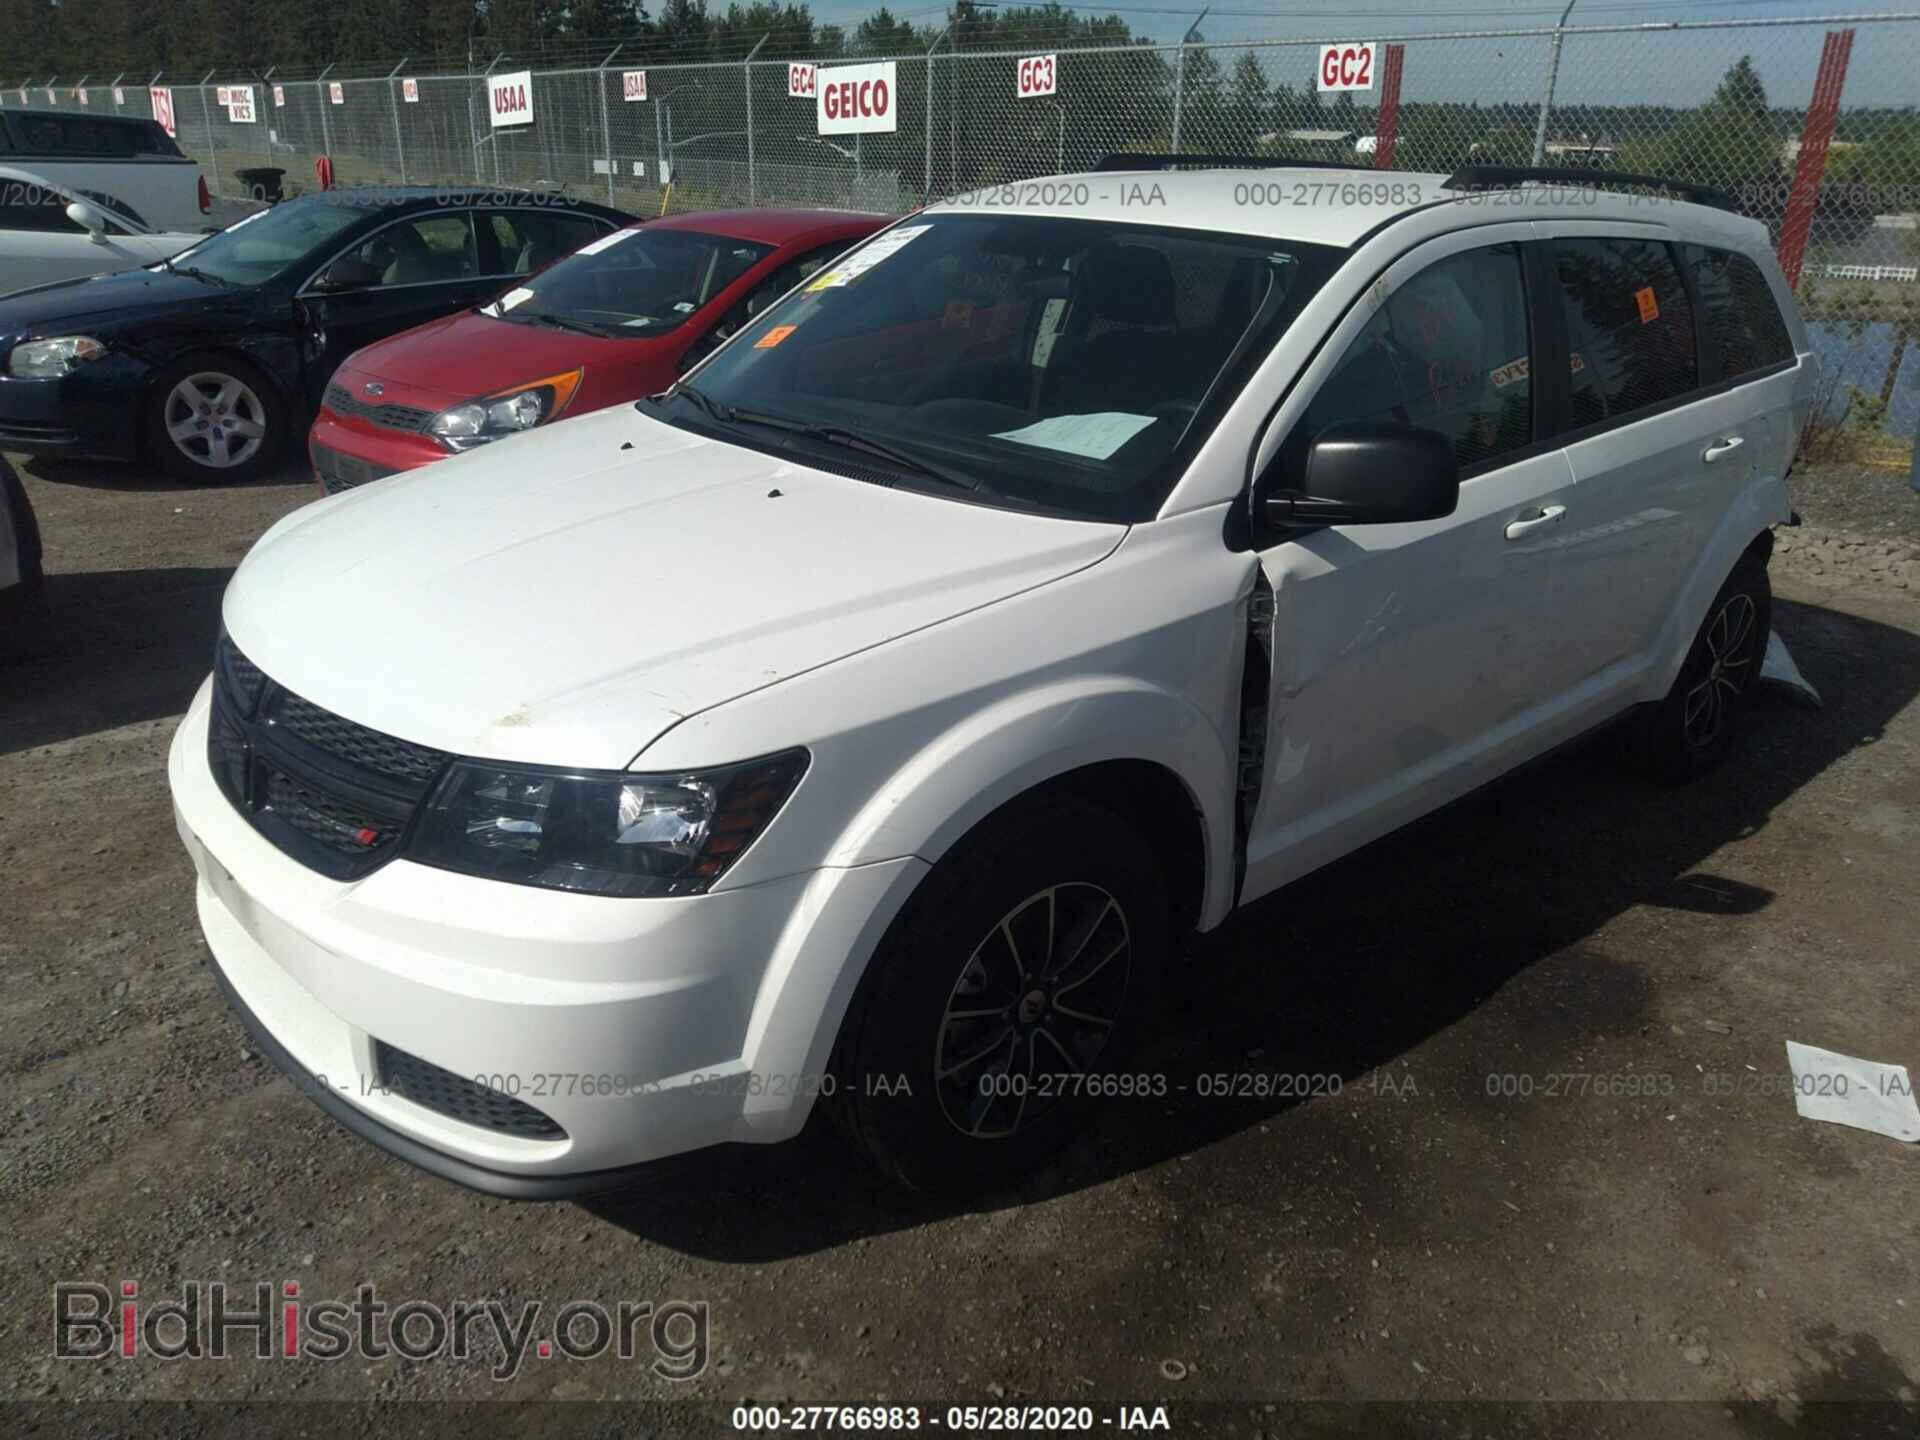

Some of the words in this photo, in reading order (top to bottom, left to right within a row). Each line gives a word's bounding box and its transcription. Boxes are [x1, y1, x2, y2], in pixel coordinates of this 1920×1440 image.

[790, 65, 815, 94] GC4
[1020, 58, 1053, 93] GC3
[1322, 47, 1371, 86] GC2
[494, 84, 527, 114] USAA
[623, 72, 646, 97] USAA
[824, 78, 889, 120] GEICO
